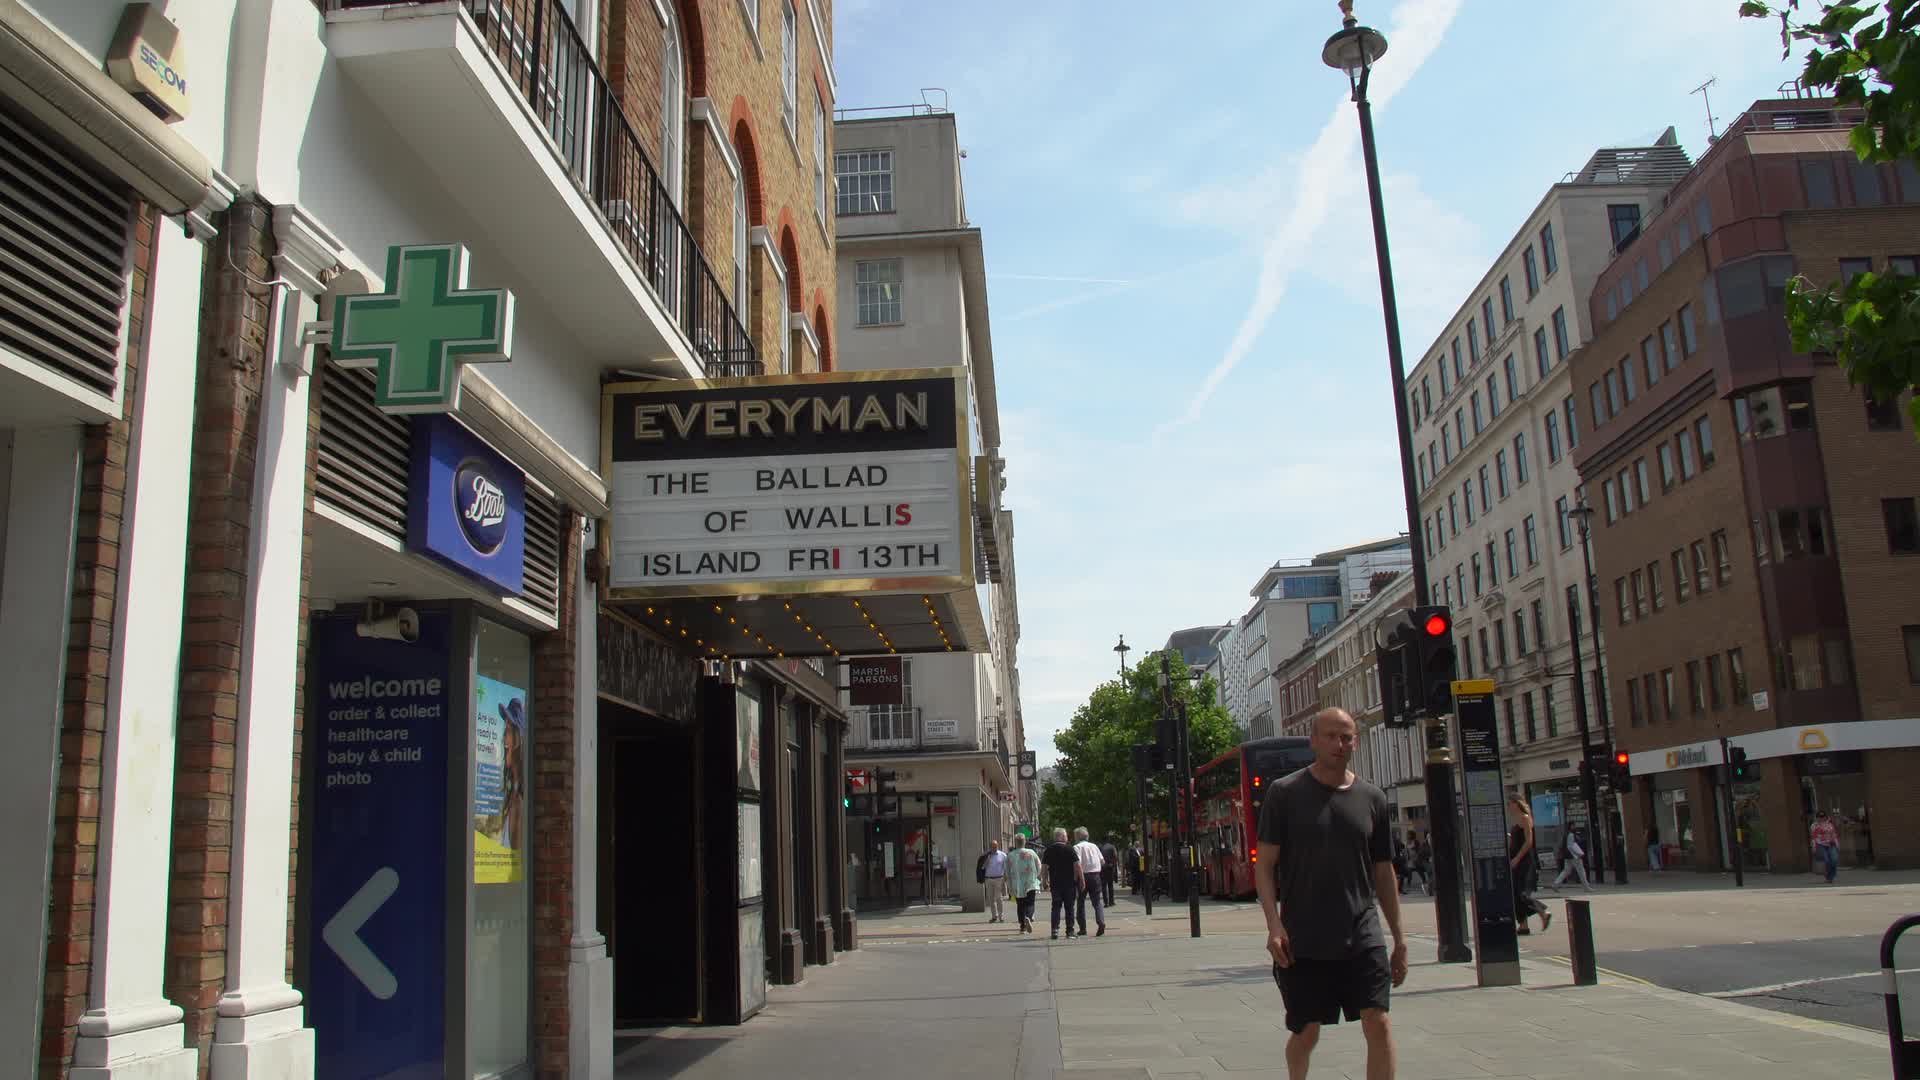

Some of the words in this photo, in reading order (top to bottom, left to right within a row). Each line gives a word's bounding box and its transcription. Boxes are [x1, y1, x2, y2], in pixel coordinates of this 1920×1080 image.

[140, 44, 187, 96] SECOM
[634, 391, 929, 440] EVERYMAN
[646, 472, 710, 495] THE
[755, 465, 888, 491] BALLAD
[465, 475, 505, 527] Boots
[704, 510, 748, 533] OF
[785, 503, 912, 530] WALLIS
[642, 551, 761, 576] ISLAND
[788, 547, 840, 571] FRI
[857, 543, 940, 568] 13TH
[852, 667, 887, 677] MARSH
[852, 675, 899, 685] PARSONS
[329, 675, 441, 698] welcome
[328, 707, 371, 721] order
[375, 705, 385, 719] &
[390, 703, 440, 719] collect
[477, 712, 488, 723] Are
[328, 727, 409, 742] healthcare
[327, 748, 364, 766] baby
[368, 748, 380, 762] &
[384, 747, 421, 762] child
[327, 772, 372, 788] photo
